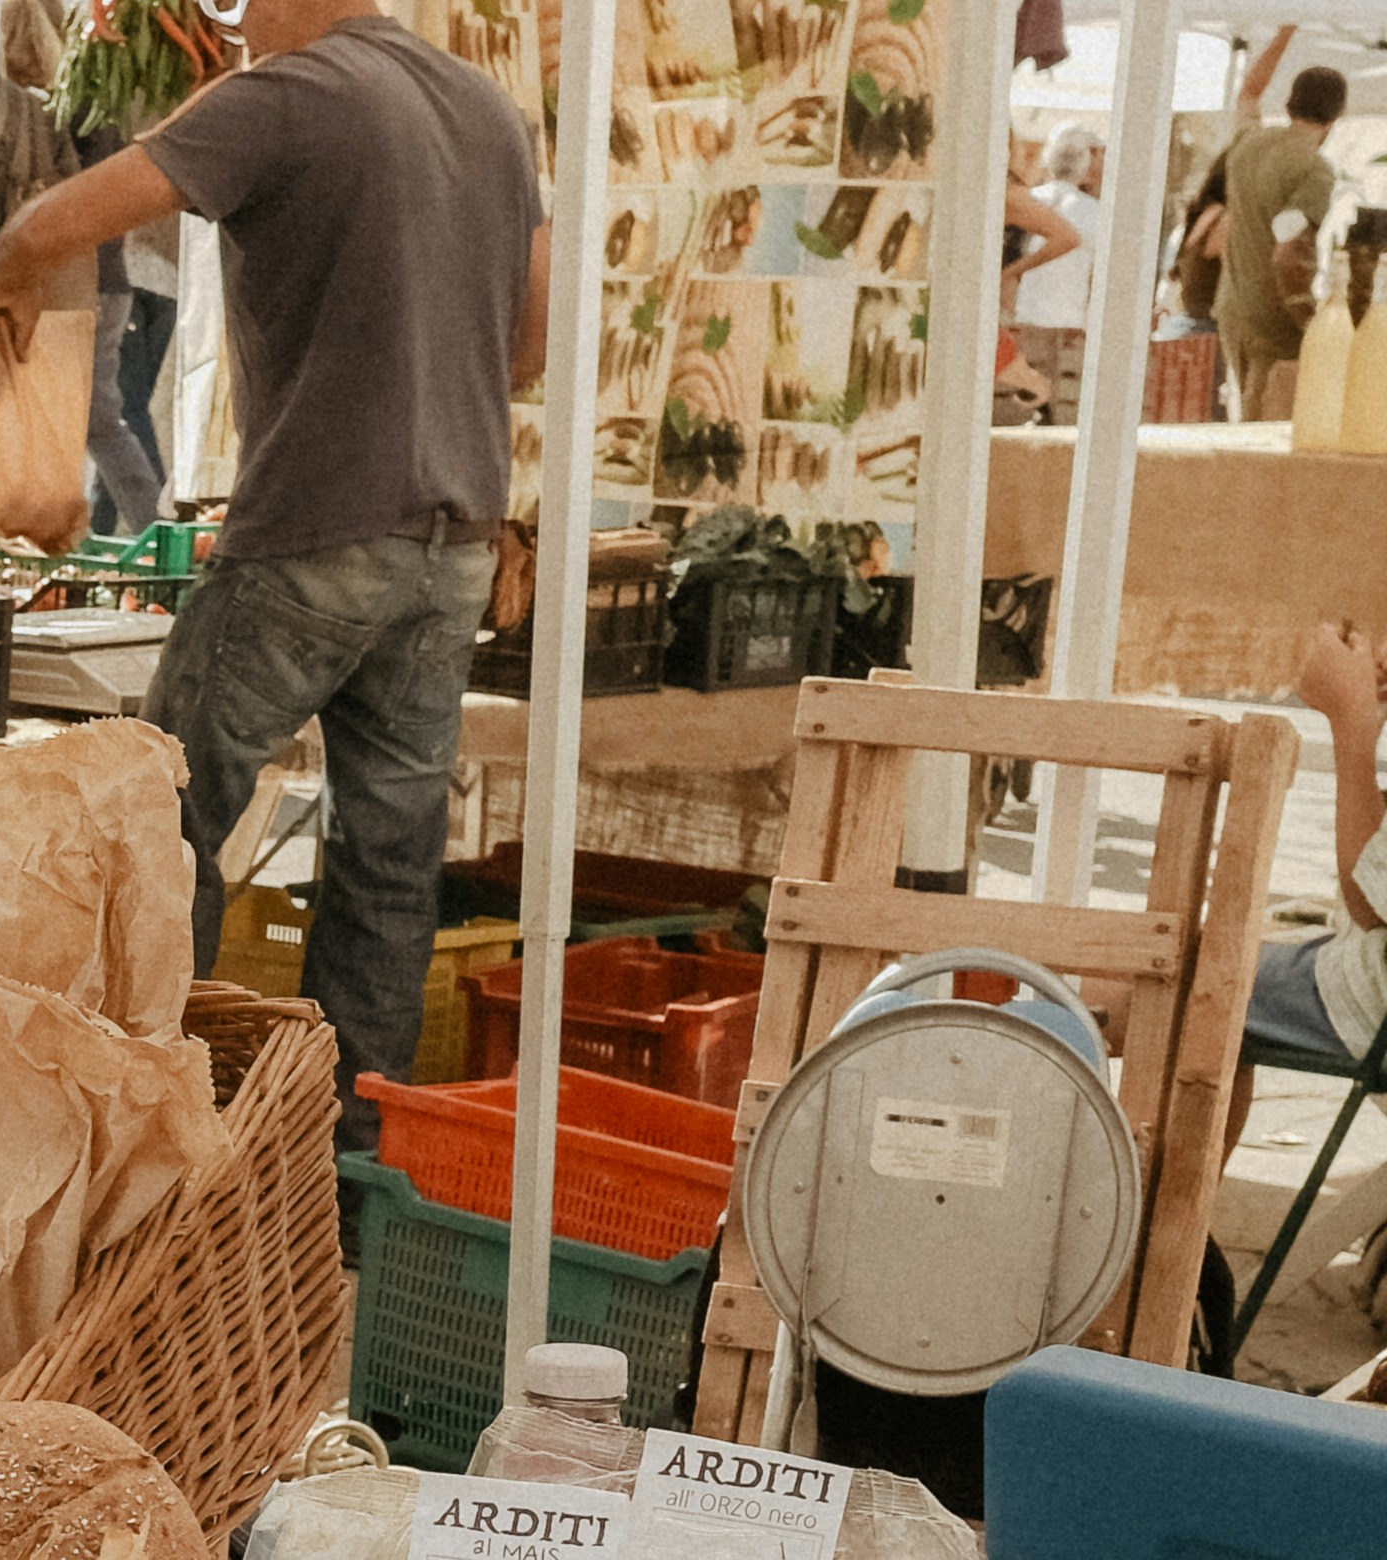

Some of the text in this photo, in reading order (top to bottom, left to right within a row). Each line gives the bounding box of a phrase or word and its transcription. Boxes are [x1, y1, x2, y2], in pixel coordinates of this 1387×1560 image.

[658, 1446, 835, 1503] ARDITI
[434, 1498, 609, 1546] ARDITI
[700, 1493, 761, 1519] ORZO
[769, 1508, 817, 1529] nero
[474, 1539, 491, 1556] al
